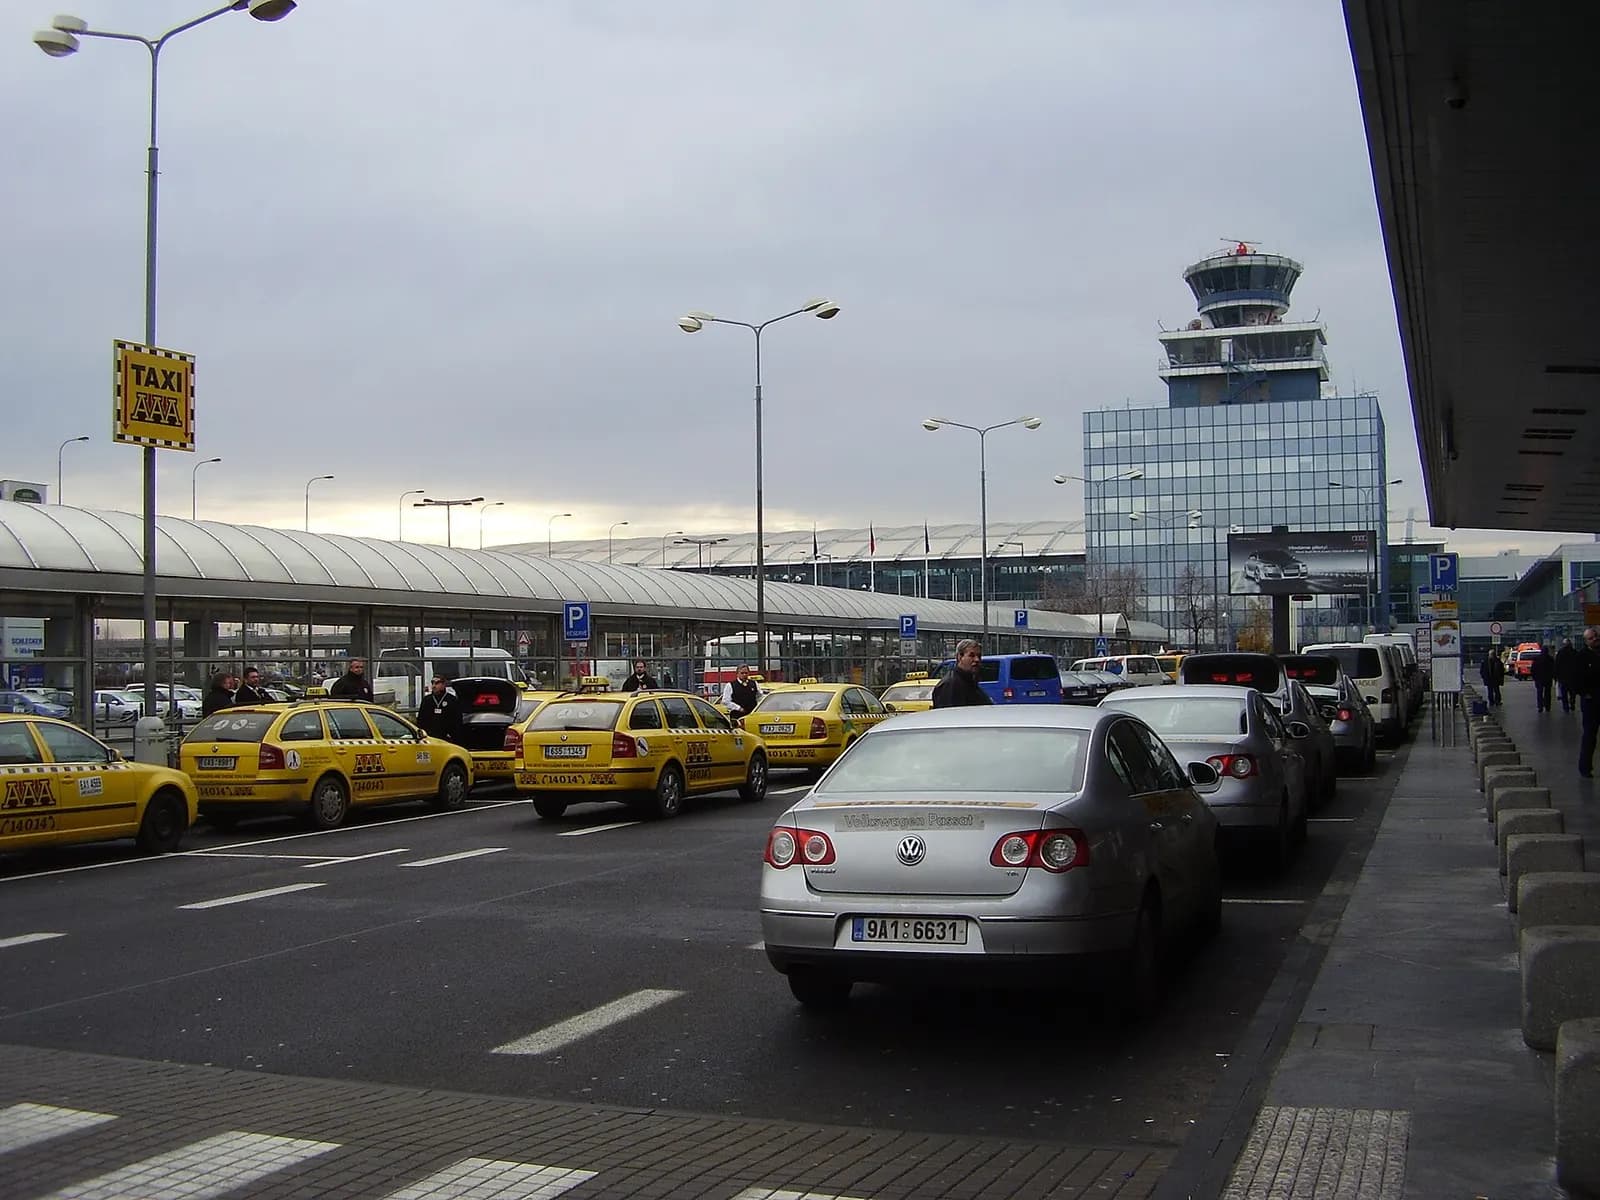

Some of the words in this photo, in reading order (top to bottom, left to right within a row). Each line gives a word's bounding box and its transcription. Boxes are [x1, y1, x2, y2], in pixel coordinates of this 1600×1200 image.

[131, 364, 182, 393] TAXI
[131, 392, 182, 427] AAA
[1436, 557, 1451, 579] P
[569, 606, 584, 629] P
[903, 617, 913, 632] P
[1017, 611, 1025, 623] P
[353, 753, 385, 774] AAA
[548, 774, 577, 784] 14014
[2, 778, 57, 809] AAA
[9, 817, 49, 833] 14014
[844, 813, 926, 828] Volkswagen
[928, 812, 974, 826] Passat
[867, 919, 899, 940] 9A1
[913, 921, 957, 941] 6631
